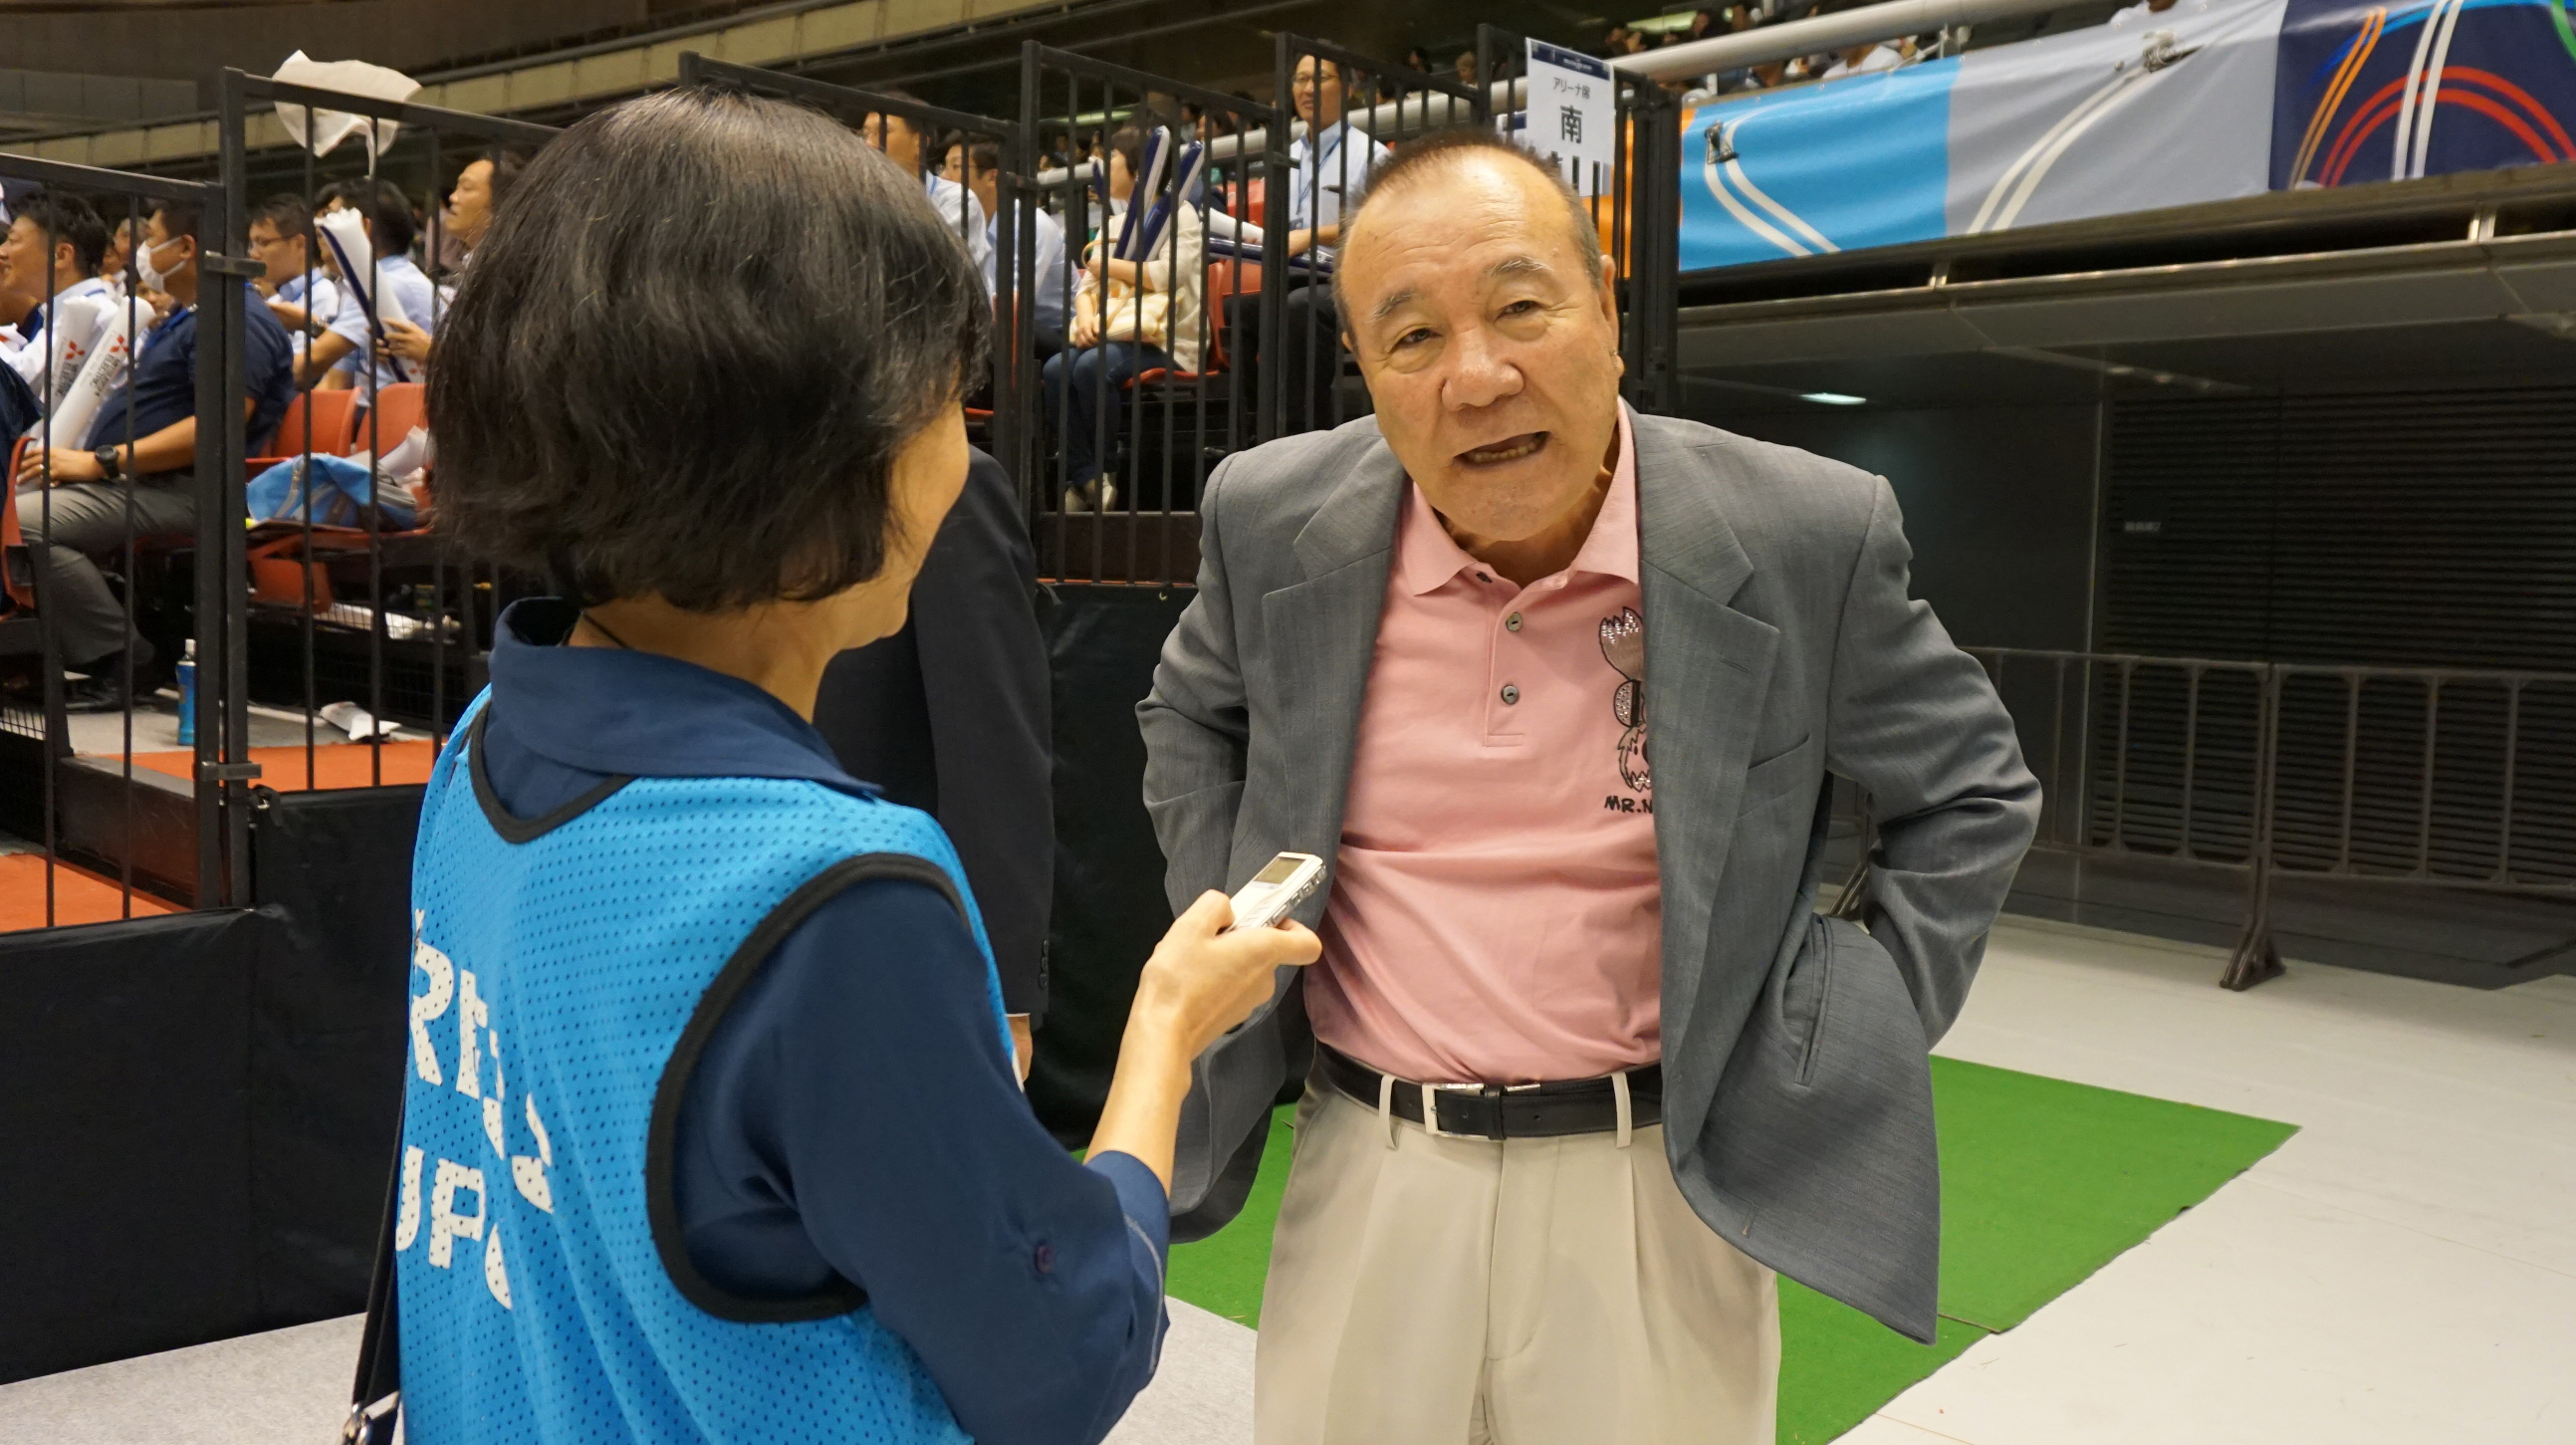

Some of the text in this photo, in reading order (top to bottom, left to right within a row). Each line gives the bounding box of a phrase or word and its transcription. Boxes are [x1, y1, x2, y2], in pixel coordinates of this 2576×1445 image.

[1553, 78, 1590, 100] アリーナ席
[1560, 106, 1583, 143] 南
